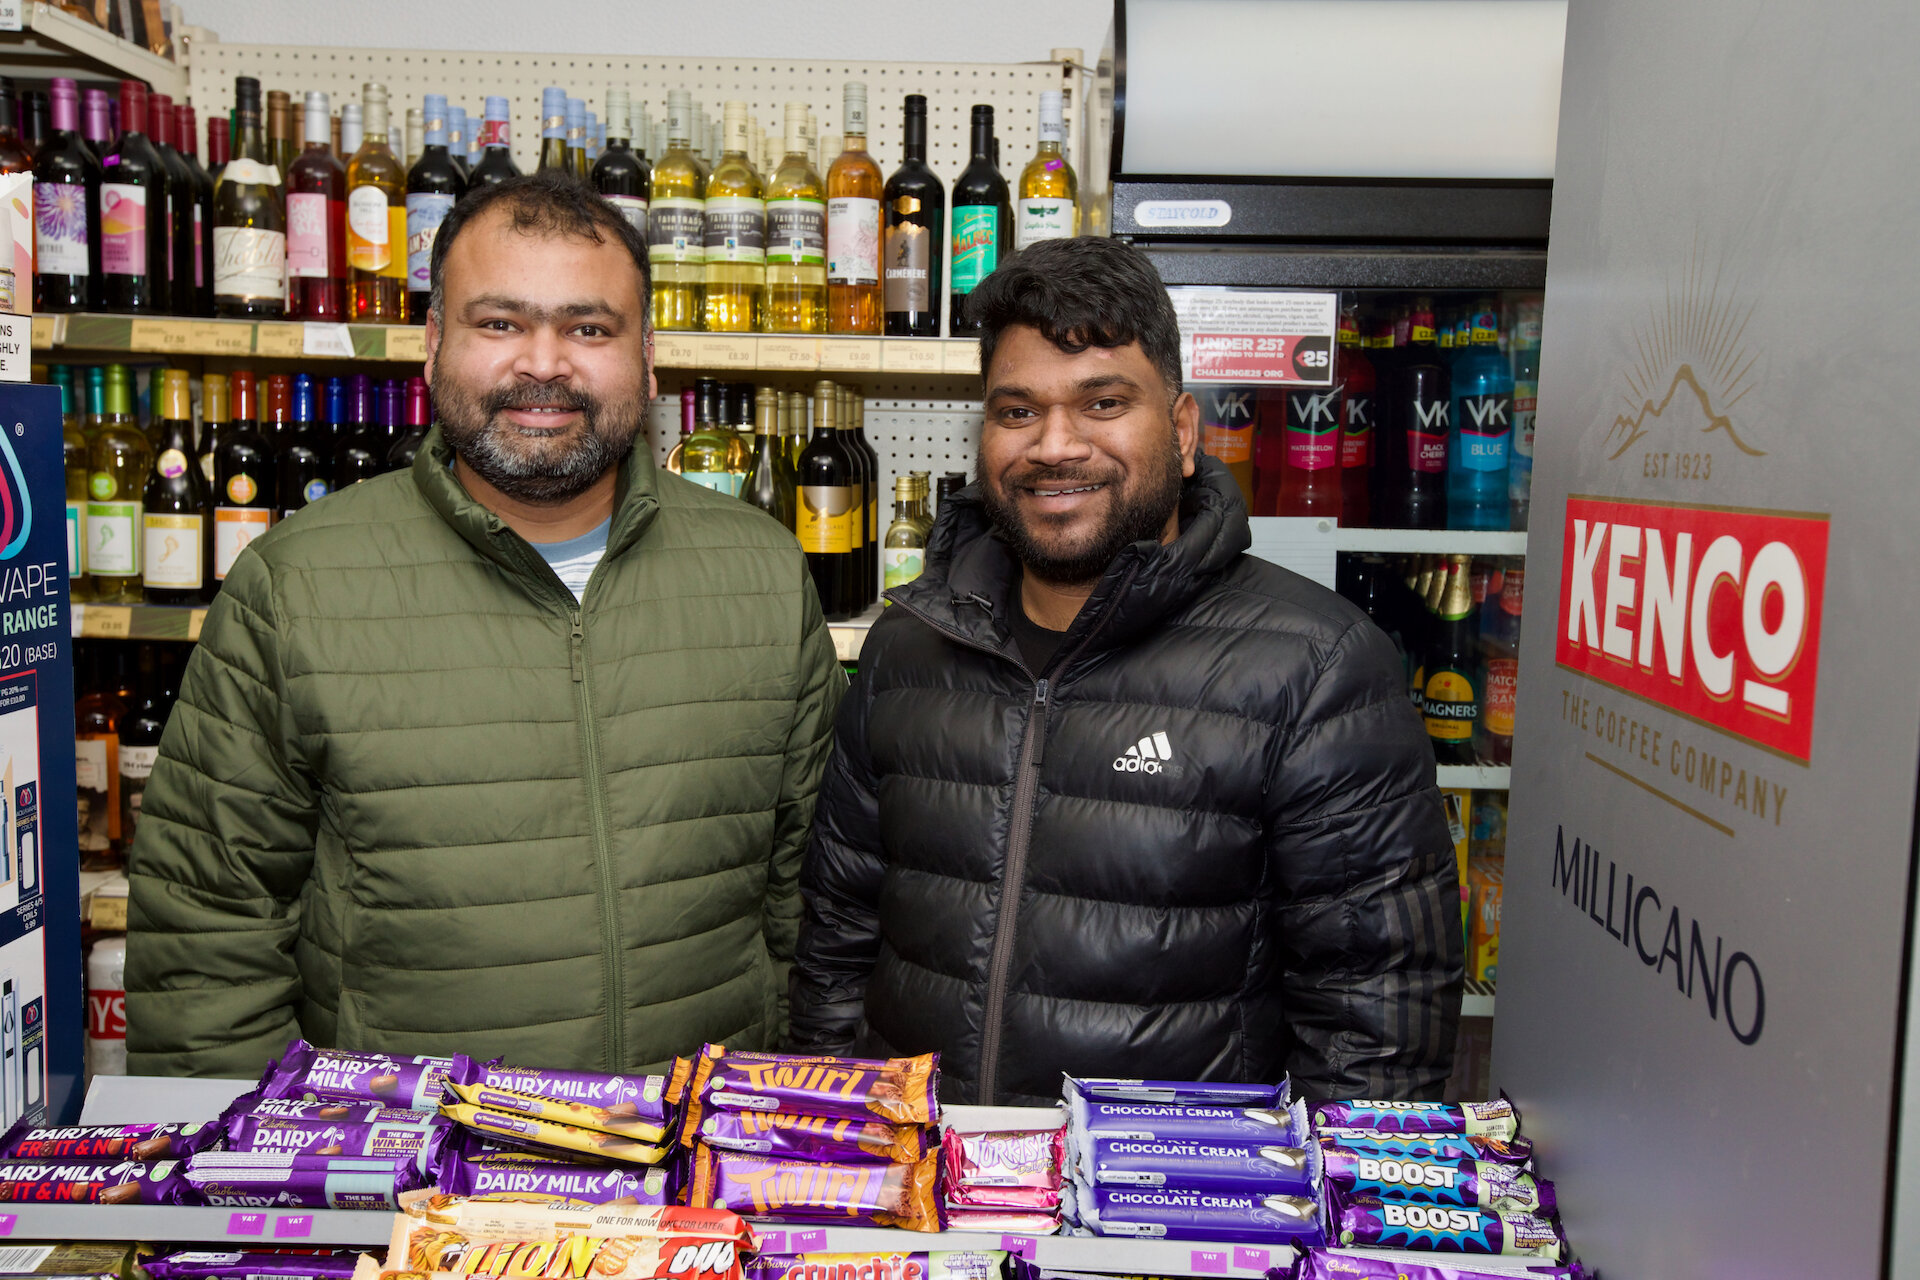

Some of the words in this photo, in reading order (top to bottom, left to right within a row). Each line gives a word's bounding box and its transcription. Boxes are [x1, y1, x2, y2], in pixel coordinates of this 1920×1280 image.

[658, 215, 703, 225] FAIRTRADE
[710, 214, 755, 224] FAIRTRADE
[775, 214, 819, 225] FAIRTRADE
[1149, 207, 1218, 219] STAYCOLD
[952, 229, 993, 257] MALBEC
[0, 343, 20, 354] HLY
[1196, 337, 1254, 350] UNDER
[1257, 338, 1285, 351] 25?
[1303, 351, 1328, 367] 25
[1195, 369, 1284, 377] CHALLENGE25.ORG
[1211, 391, 1249, 419] VK
[1292, 394, 1335, 423] VK
[1466, 399, 1508, 426] VK
[1413, 400, 1449, 428] VK
[1471, 444, 1502, 455] BLUE
[1643, 453, 1669, 478] EST
[1675, 453, 1712, 482] 1923
[3, 603, 58, 635] RANGE
[1567, 518, 1807, 706] KENCO
[0, 643, 21, 669] 20
[24, 642, 58, 665] (BASE)
[1562, 690, 1588, 730] THE
[1596, 706, 1661, 766] COFFEE
[1671, 739, 1787, 827] COMPANY
[1552, 824, 1766, 1046] MILLICANO
[311, 1056, 378, 1074] DAIRY
[488, 1064, 543, 1078] Cadbury
[304, 1070, 357, 1090] MILK
[486, 1075, 556, 1093] DAIRY
[552, 1079, 604, 1099] MILK
[727, 1062, 865, 1100] Twirl
[253, 1104, 307, 1117] MILK
[1100, 1105, 1184, 1117] CHOCOLATE
[1186, 1108, 1234, 1118] CREAM
[1351, 1100, 1443, 1111] BOOST
[258, 1118, 299, 1130] Cadbury
[25, 1128, 91, 1140] DAIRY
[253, 1129, 322, 1147] DAIRY
[75, 1139, 89, 1155] &
[372, 1138, 425, 1149] WIN-WIN
[965, 1132, 1055, 1171] TURKISH
[1109, 1142, 1197, 1156] CHOCOLATE
[1199, 1146, 1250, 1158] CREAM
[719, 1151, 771, 1165] Cadbury
[50, 1166, 111, 1181] MILK
[478, 1160, 537, 1174] Cadbury
[1359, 1158, 1459, 1189] BOOST
[35, 1182, 52, 1200] &
[204, 1183, 247, 1196] Cadbury
[475, 1172, 550, 1192] DAIRY
[546, 1175, 602, 1194] MILK
[727, 1164, 871, 1216] Twirl
[208, 1195, 276, 1207] DAIRY
[1108, 1192, 1199, 1207] CHOCOLATE
[1201, 1196, 1253, 1208] CREAM
[596, 1216, 615, 1225] ONE
[616, 1216, 633, 1226] FOR
[635, 1218, 658, 1227] NOW
[660, 1220, 676, 1228] ONE
[679, 1220, 697, 1229] FOR
[697, 1221, 725, 1231] LATER
[1383, 1203, 1483, 1232] BOOST
[669, 1241, 735, 1275] DUO
[746, 1254, 791, 1270] Cadbury
[787, 1255, 923, 1280] crunchie
[1325, 1259, 1361, 1277] Cadbury
